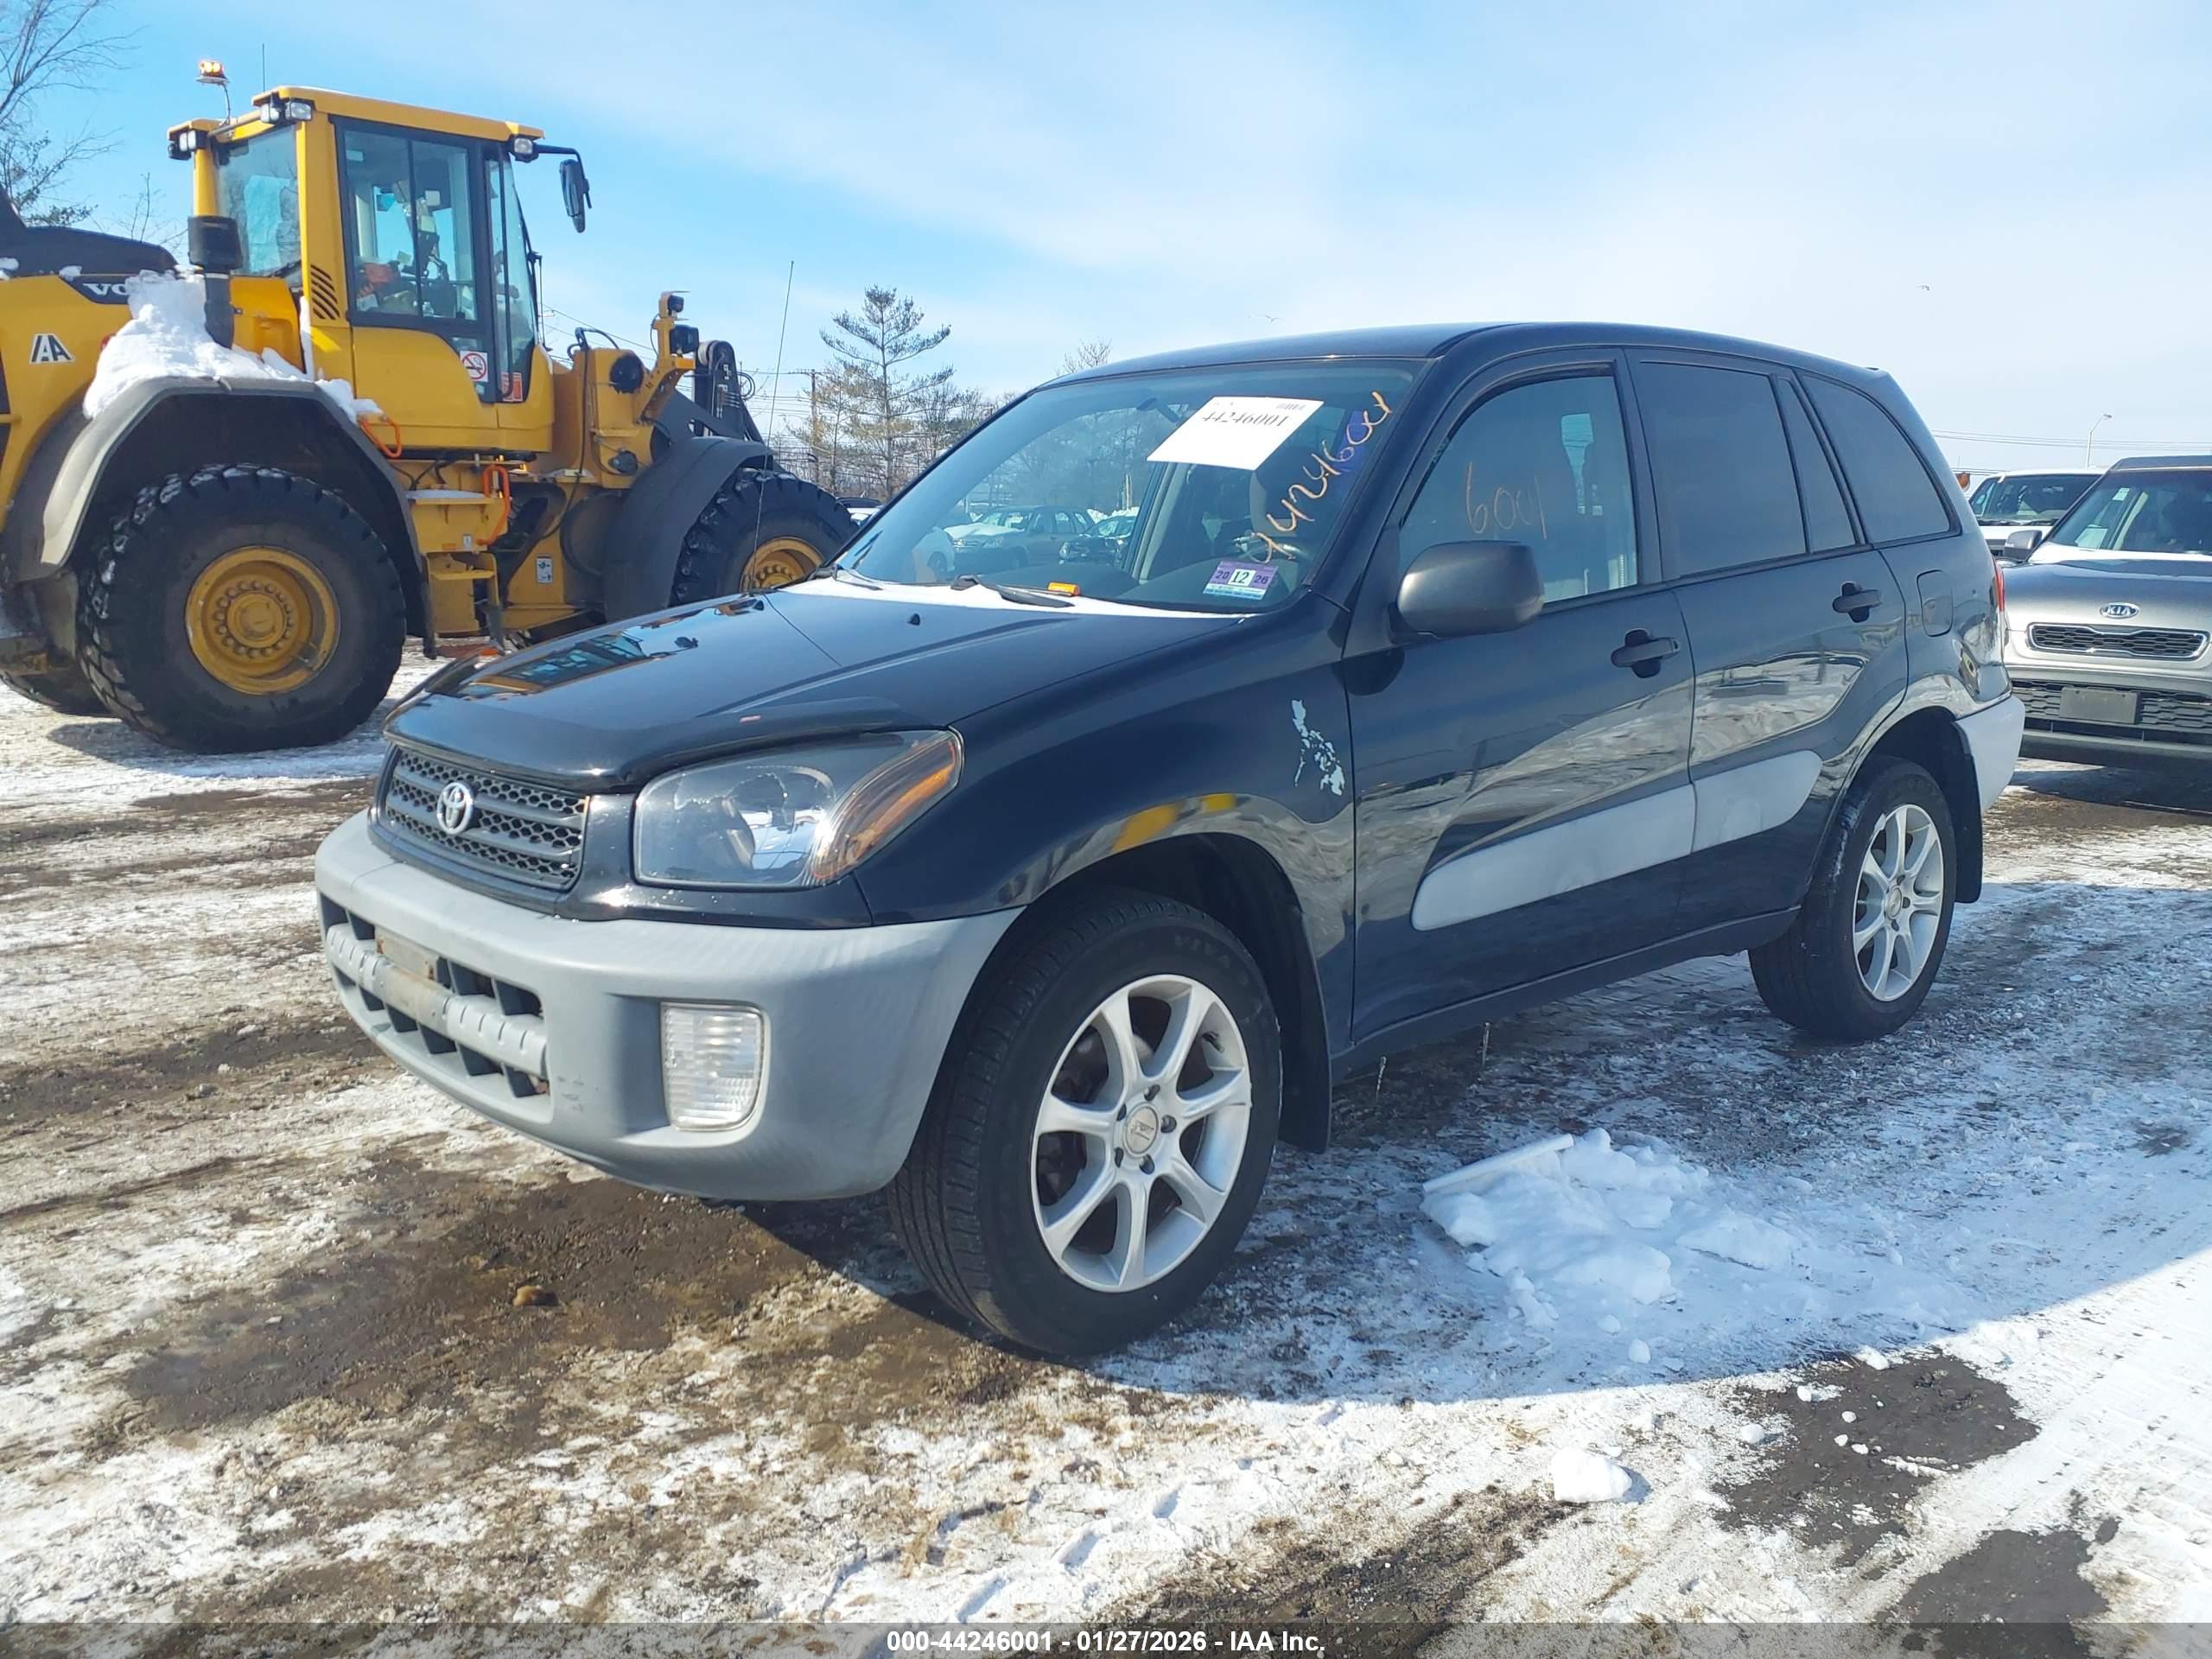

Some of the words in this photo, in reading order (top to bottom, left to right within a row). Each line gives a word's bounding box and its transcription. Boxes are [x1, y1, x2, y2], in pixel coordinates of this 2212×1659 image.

[1202, 411, 1289, 426] 44246001
[1215, 570, 1230, 580] 20
[1230, 570, 1249, 584] 12
[1253, 575, 1269, 585] 26
[2107, 606, 2131, 615] KIA
